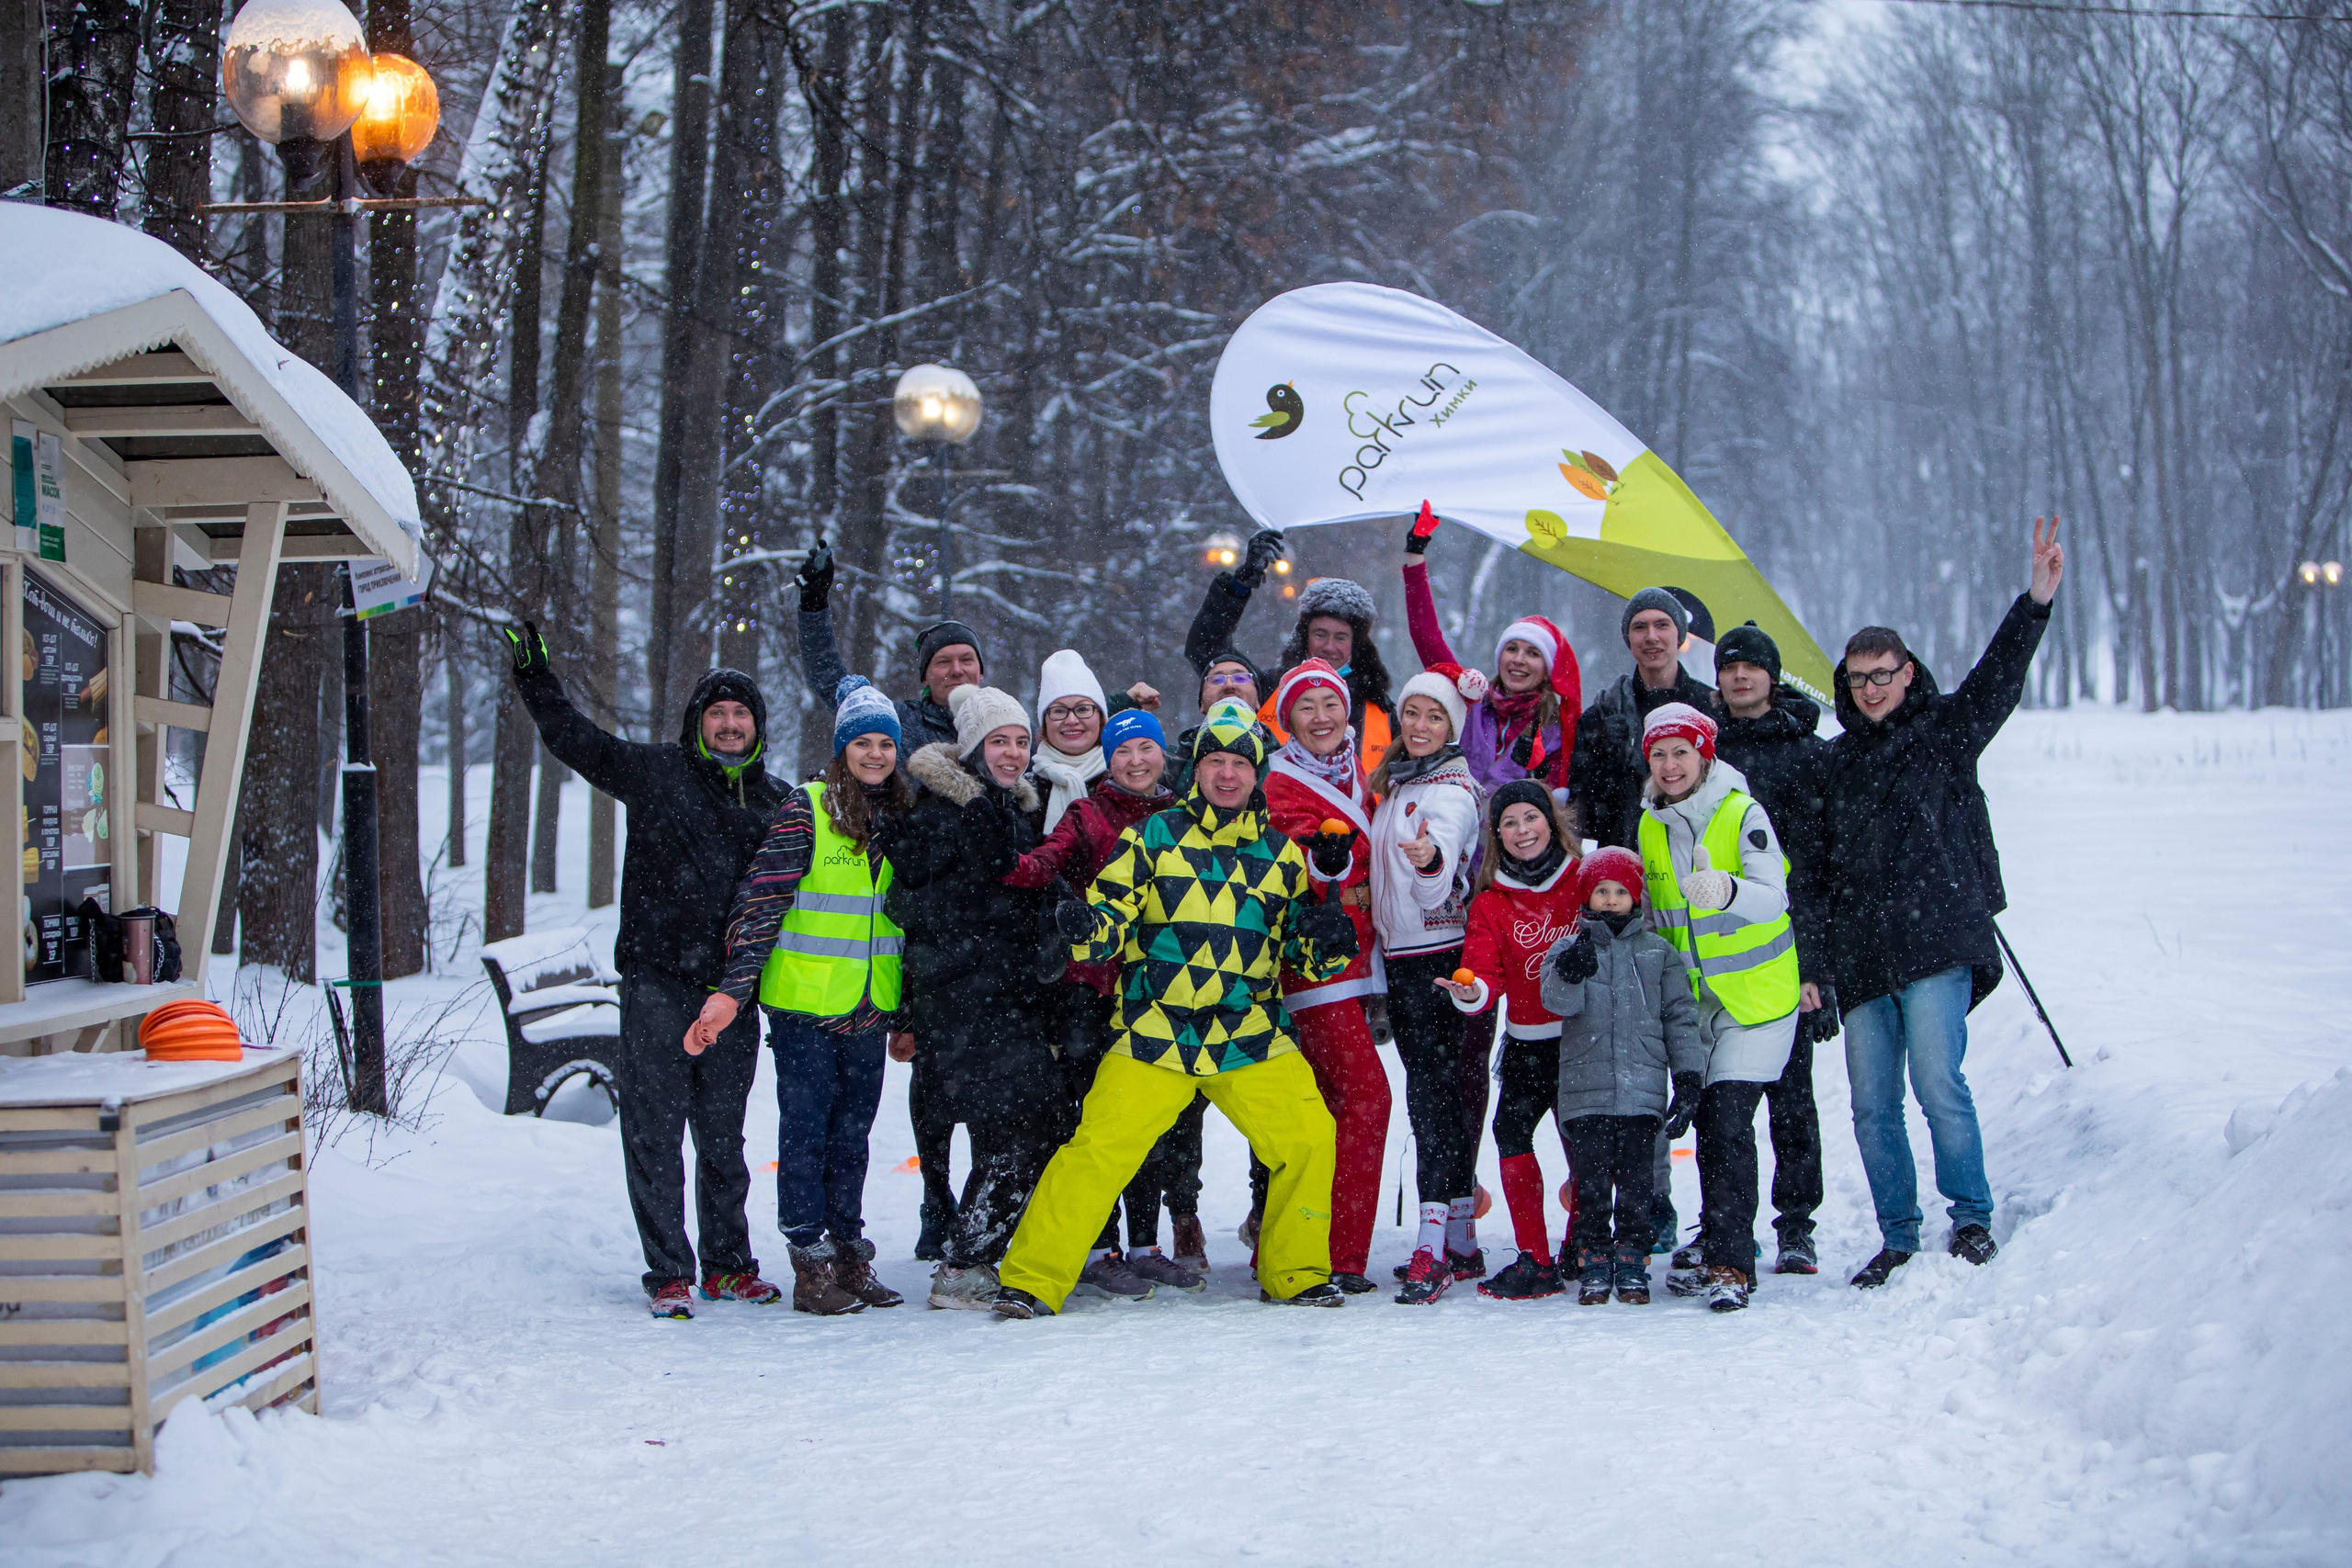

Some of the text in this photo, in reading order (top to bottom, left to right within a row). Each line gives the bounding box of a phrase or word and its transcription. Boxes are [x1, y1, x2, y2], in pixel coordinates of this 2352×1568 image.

[1428, 378, 1478, 429] ХИМКИ
[1339, 362, 1461, 502] parkrun
[823, 845, 866, 867] parkrun
